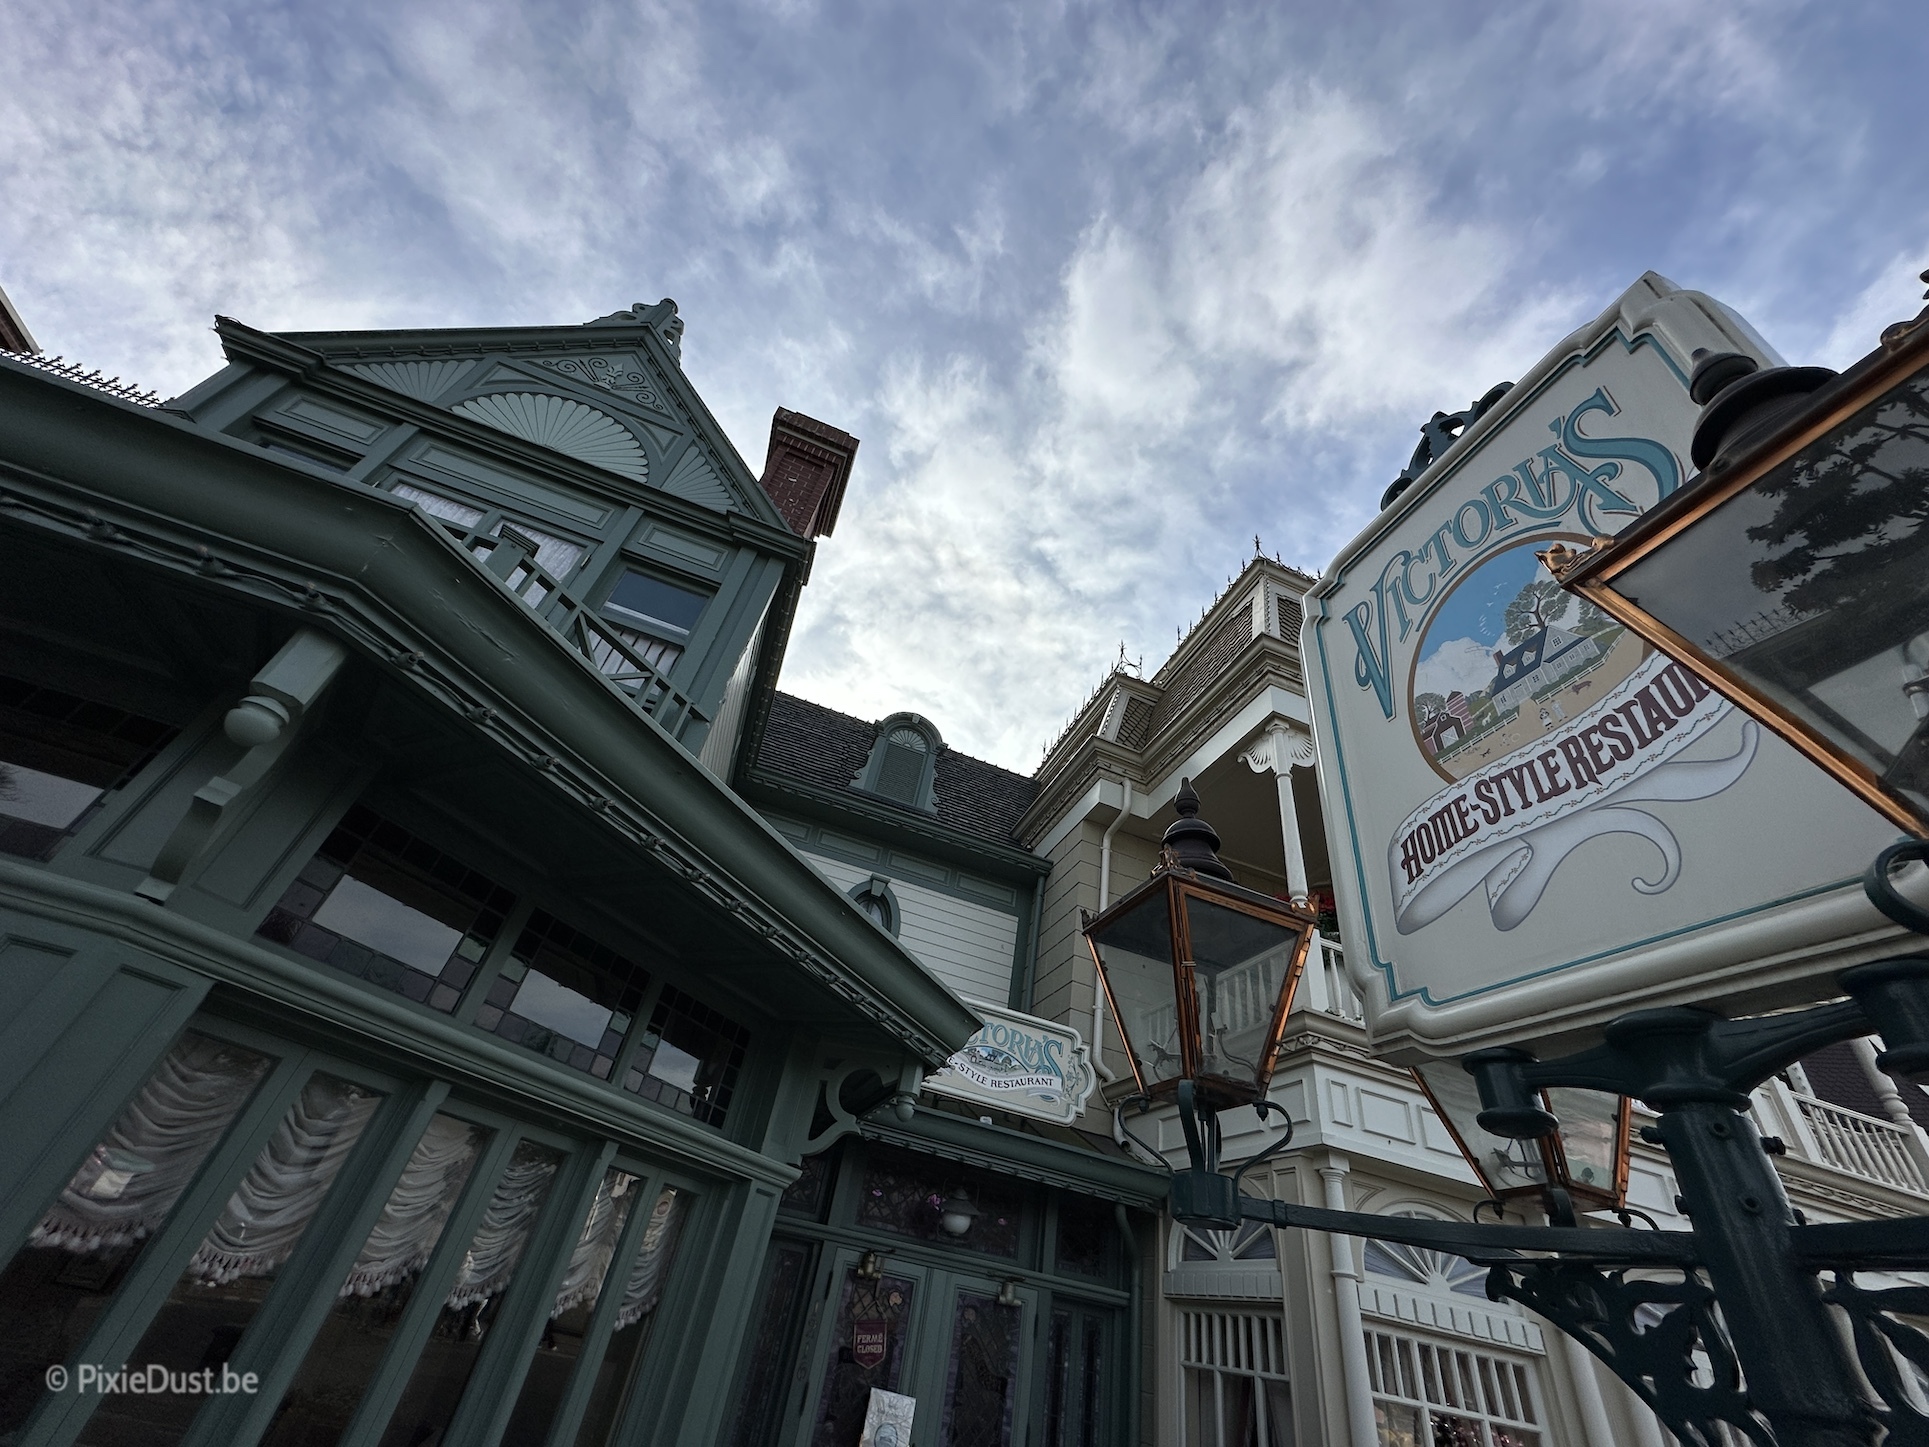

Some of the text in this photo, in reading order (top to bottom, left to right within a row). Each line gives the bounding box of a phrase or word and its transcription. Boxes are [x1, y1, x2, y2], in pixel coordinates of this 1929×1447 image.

[1342, 386, 1684, 721] VICTORIA'S
[1566, 661, 1710, 788] RESTAU
[949, 1057, 1054, 1089] E-STYLE RESTAURANT
[968, 1022, 1063, 1080] TORIA'S
[857, 1333, 883, 1343] FERMÉ
[857, 1344, 883, 1353] CLOSED
